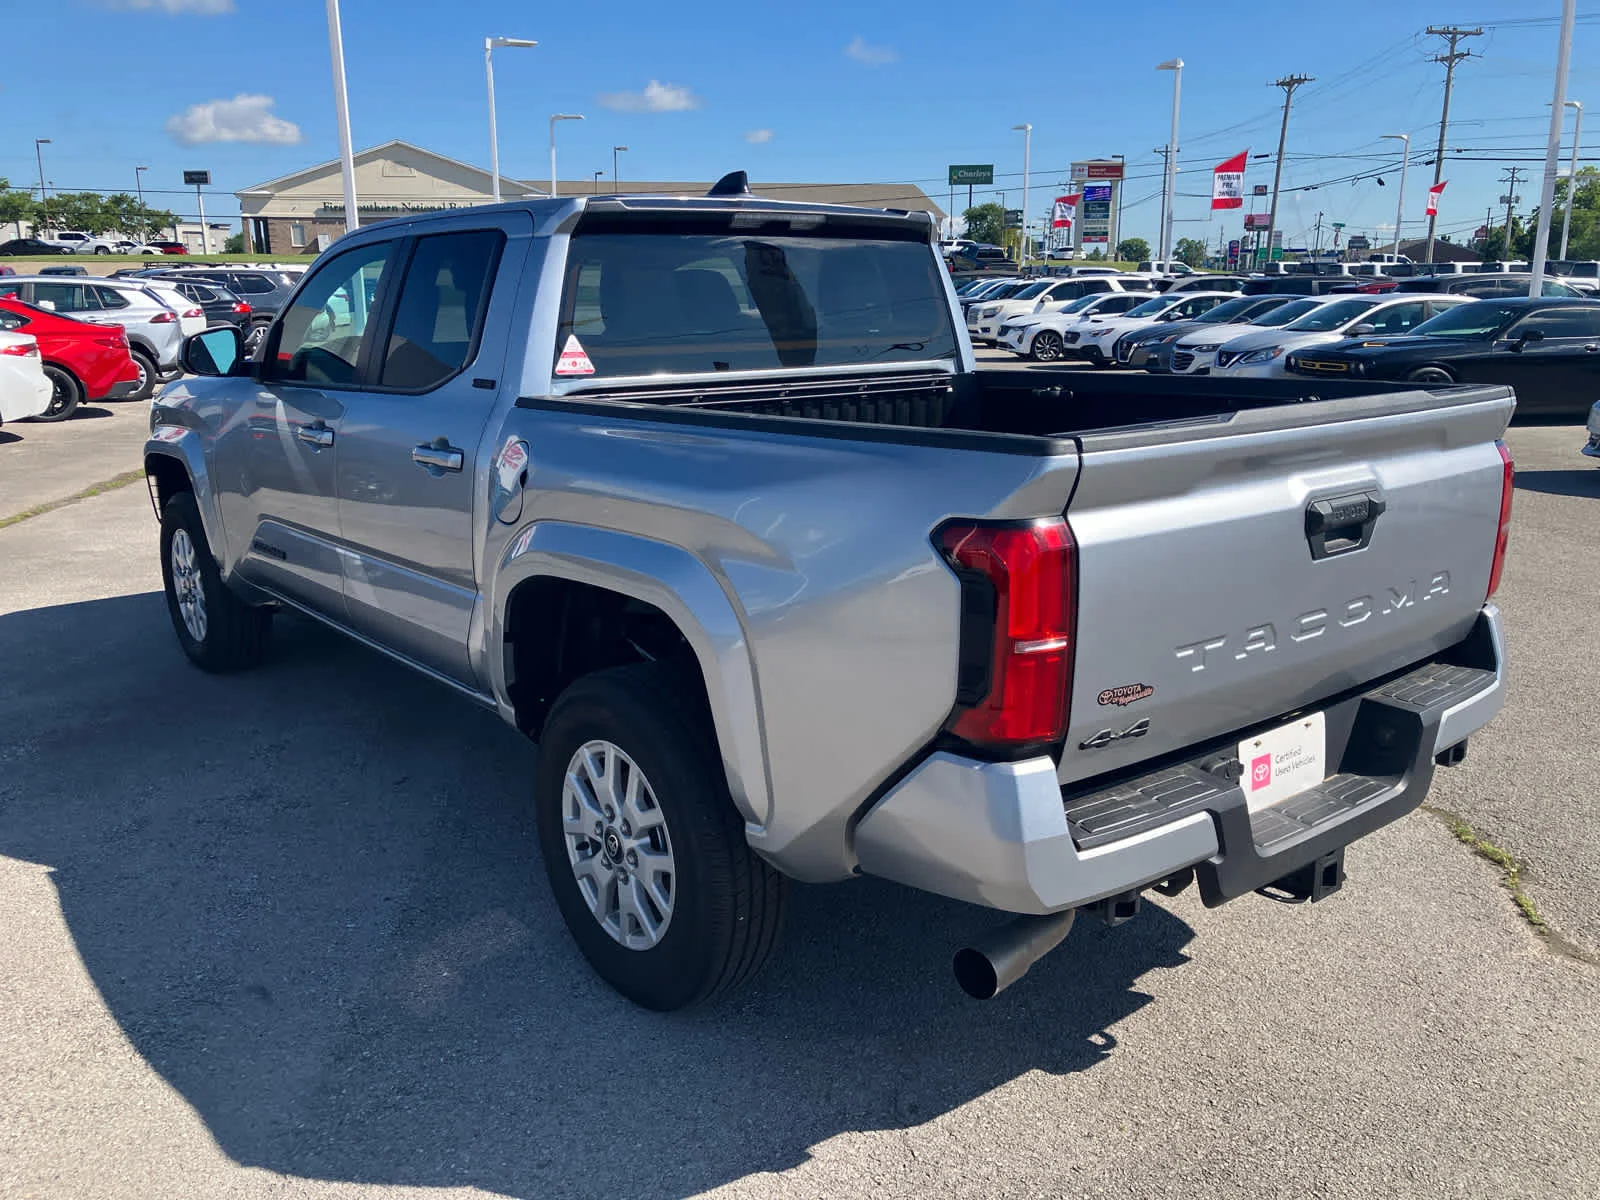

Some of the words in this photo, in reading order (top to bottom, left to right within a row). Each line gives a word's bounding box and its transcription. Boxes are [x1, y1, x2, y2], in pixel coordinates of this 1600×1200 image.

[1217, 173, 1241, 181] PREMIUM
[1222, 181, 1234, 189] PRE
[322, 201, 346, 212] Firs
[356, 201, 398, 212] outhern
[1174, 569, 1451, 673] TACOMA
[1113, 684, 1142, 697] TOYOTA
[1274, 744, 1302, 764] Certified
[1275, 764, 1291, 777] Used
